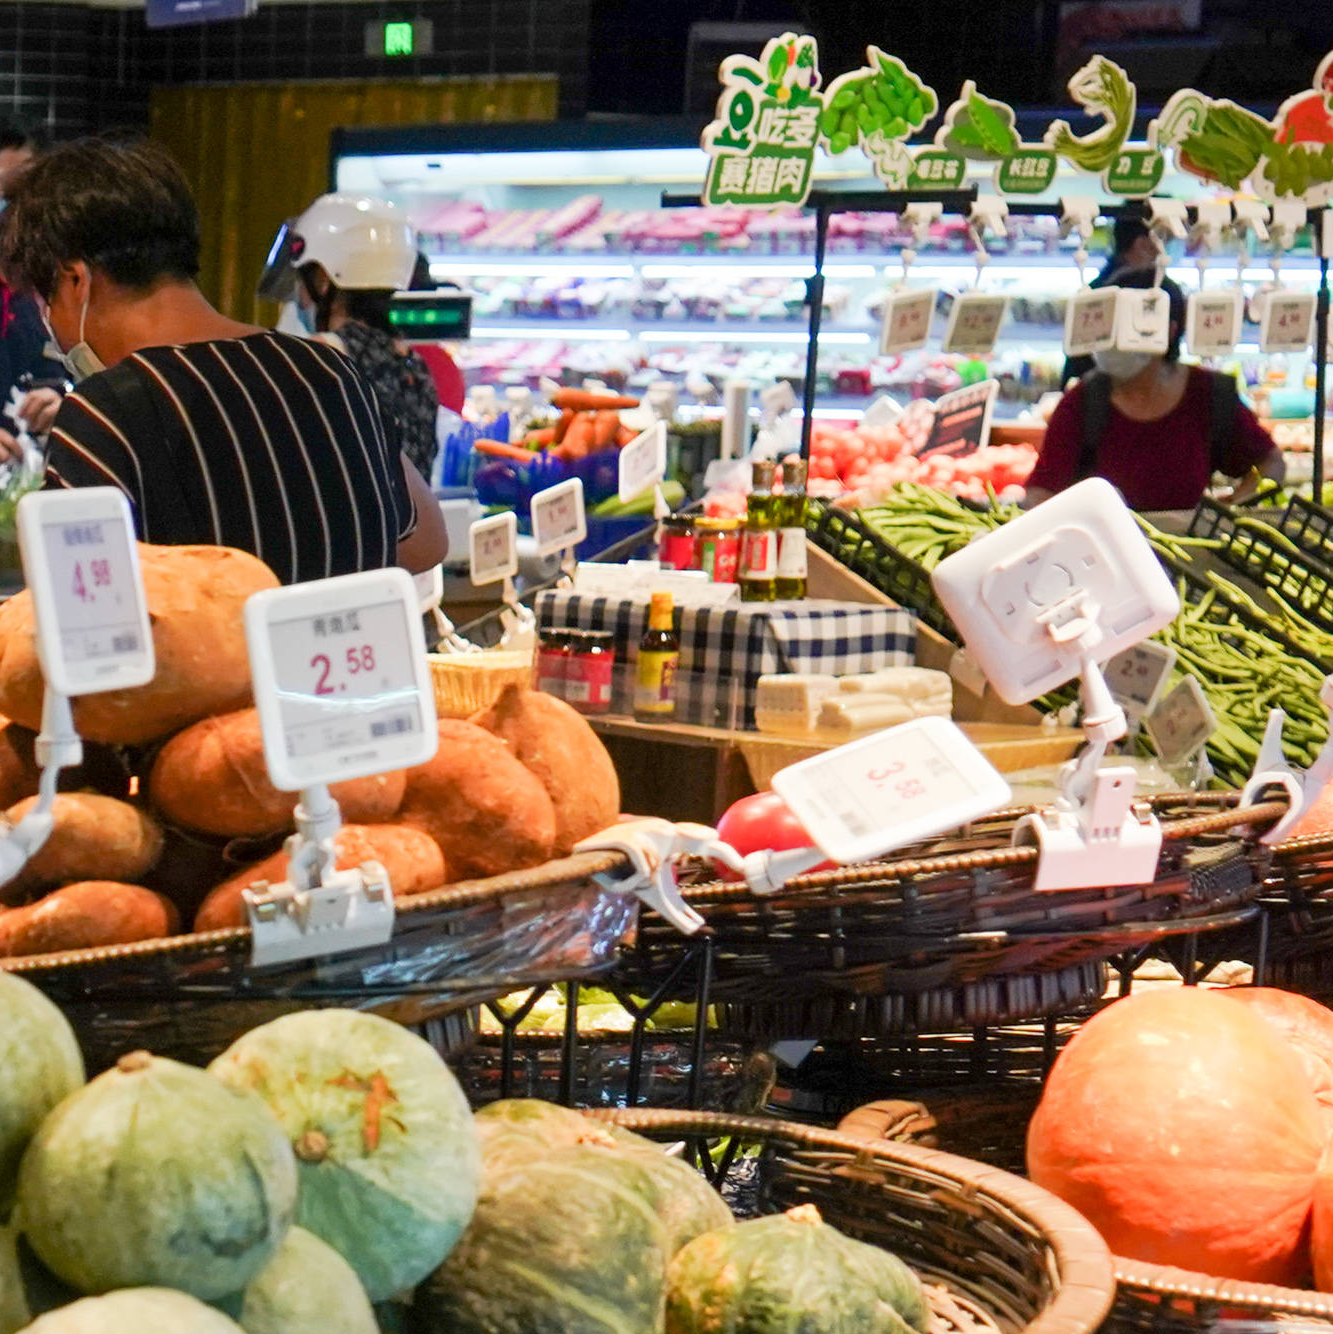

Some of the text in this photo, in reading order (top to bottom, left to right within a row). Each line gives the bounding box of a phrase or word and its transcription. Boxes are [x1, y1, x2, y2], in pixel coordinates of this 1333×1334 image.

[71, 558, 113, 604] 4.98
[309, 644, 376, 696] 2.58
[866, 761, 926, 800] 3.58
